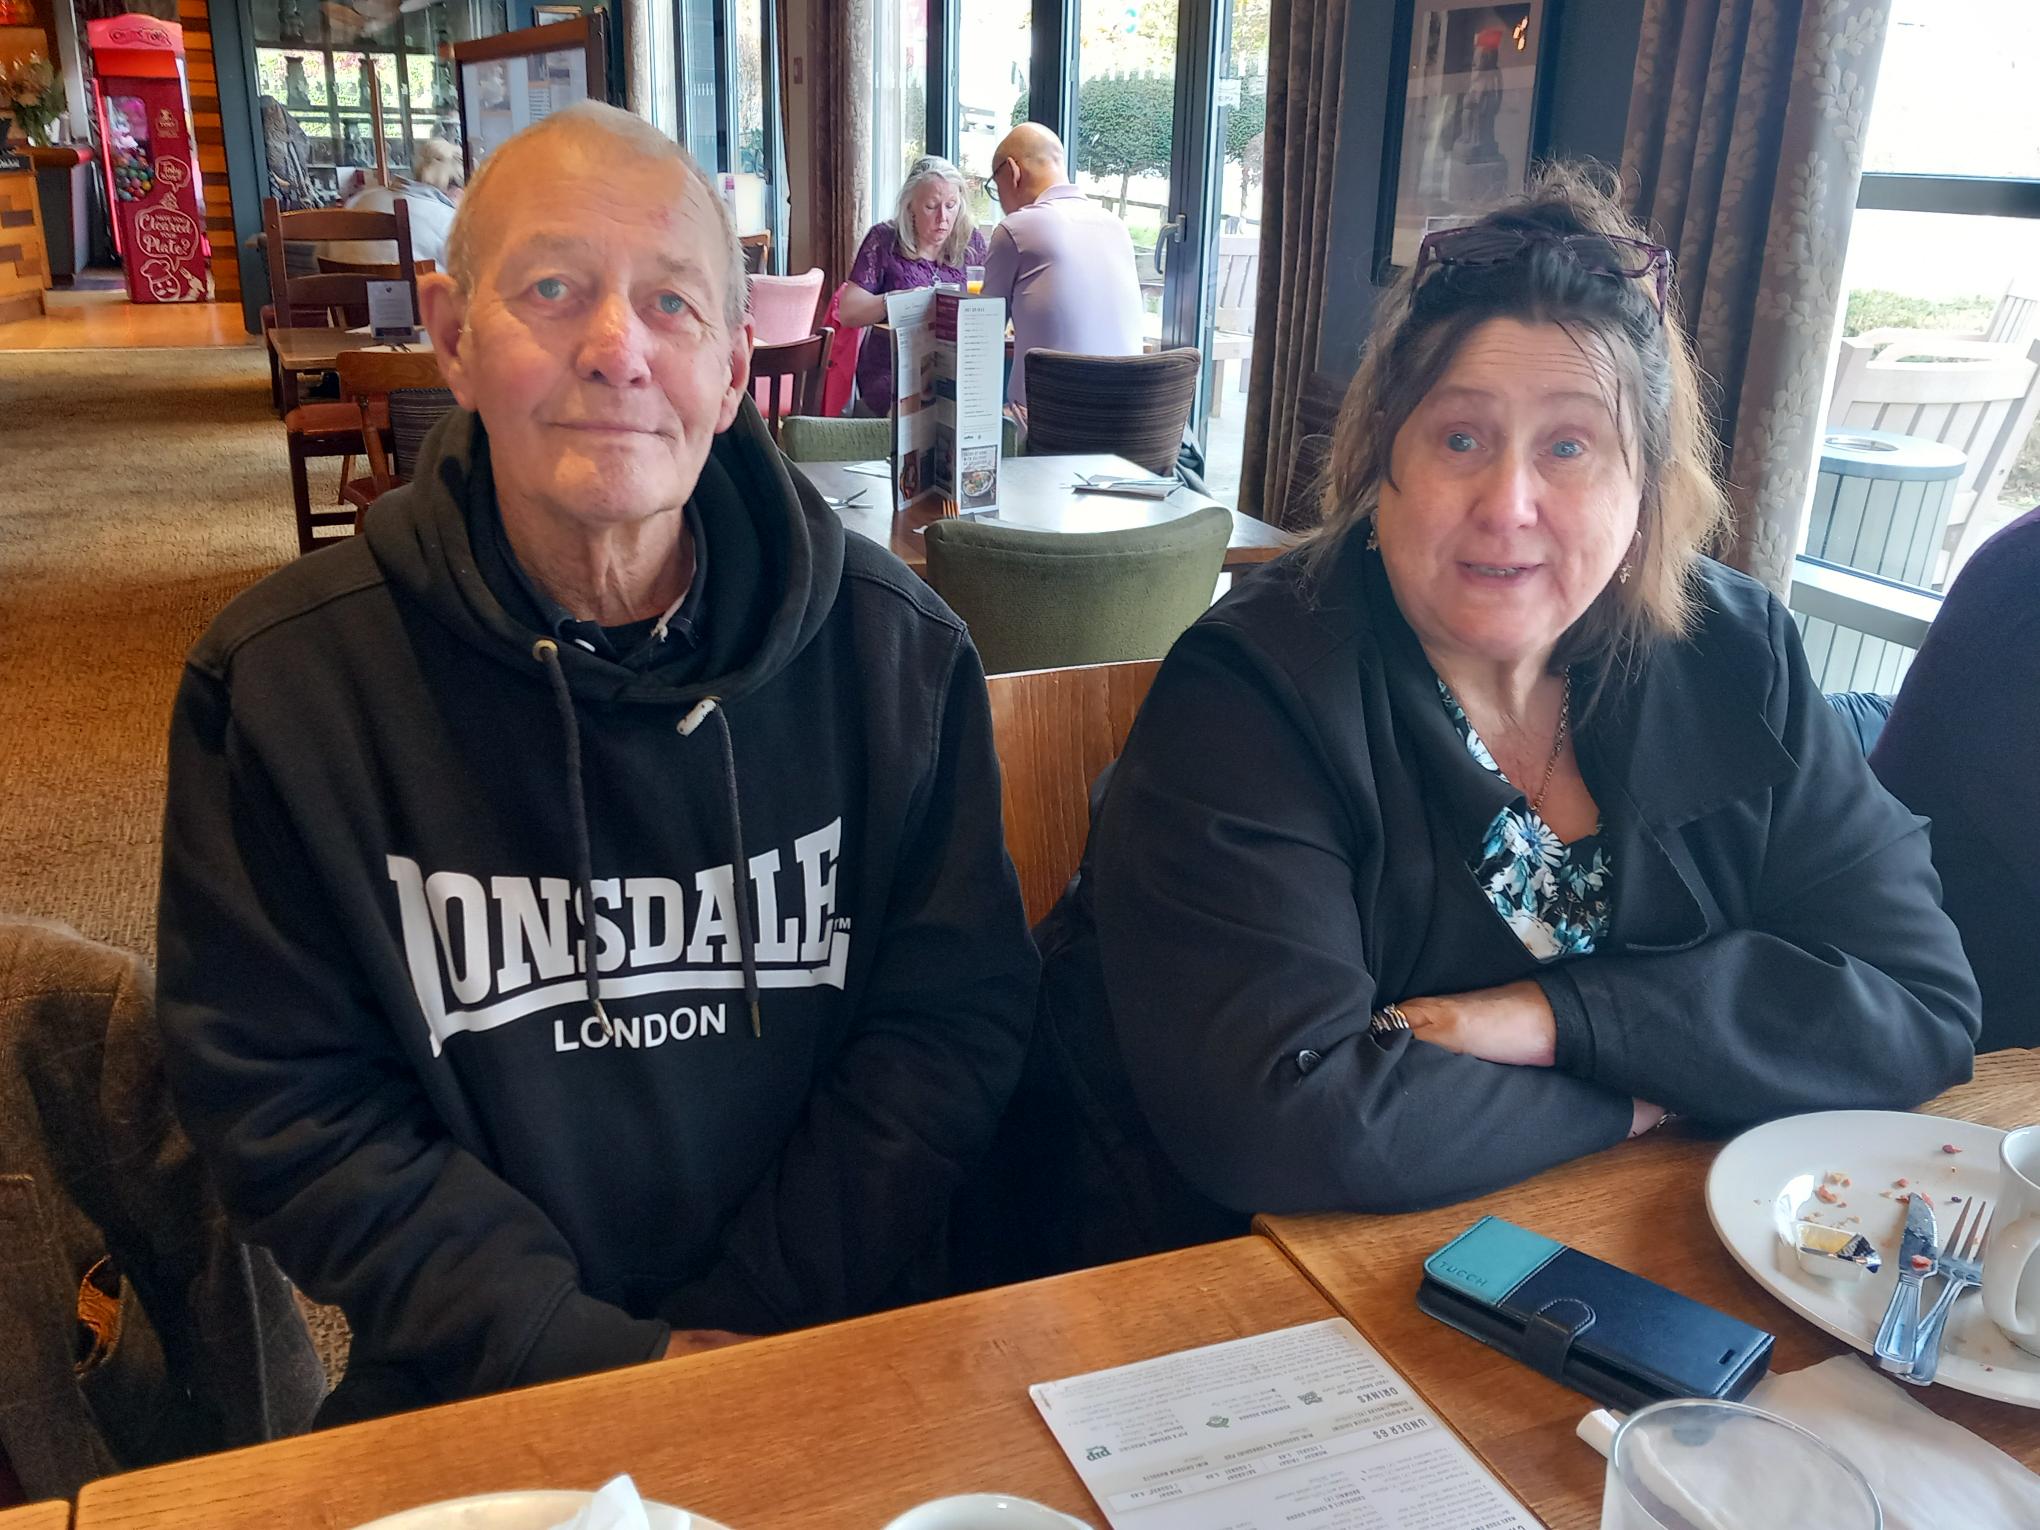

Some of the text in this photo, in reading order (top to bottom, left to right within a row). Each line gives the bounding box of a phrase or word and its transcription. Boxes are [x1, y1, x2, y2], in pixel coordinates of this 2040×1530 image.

[139, 213, 192, 234] Cleared
[143, 234, 191, 256] Plate?
[386, 816, 850, 1058] LONSDALE
[553, 1003, 727, 1053] LONDON
[1439, 1260, 1489, 1287] TUCCH
[1357, 1387, 1398, 1403] DRINKS
[1389, 1419, 1427, 1434] UNDER
[1084, 1447, 1111, 1461] pip
